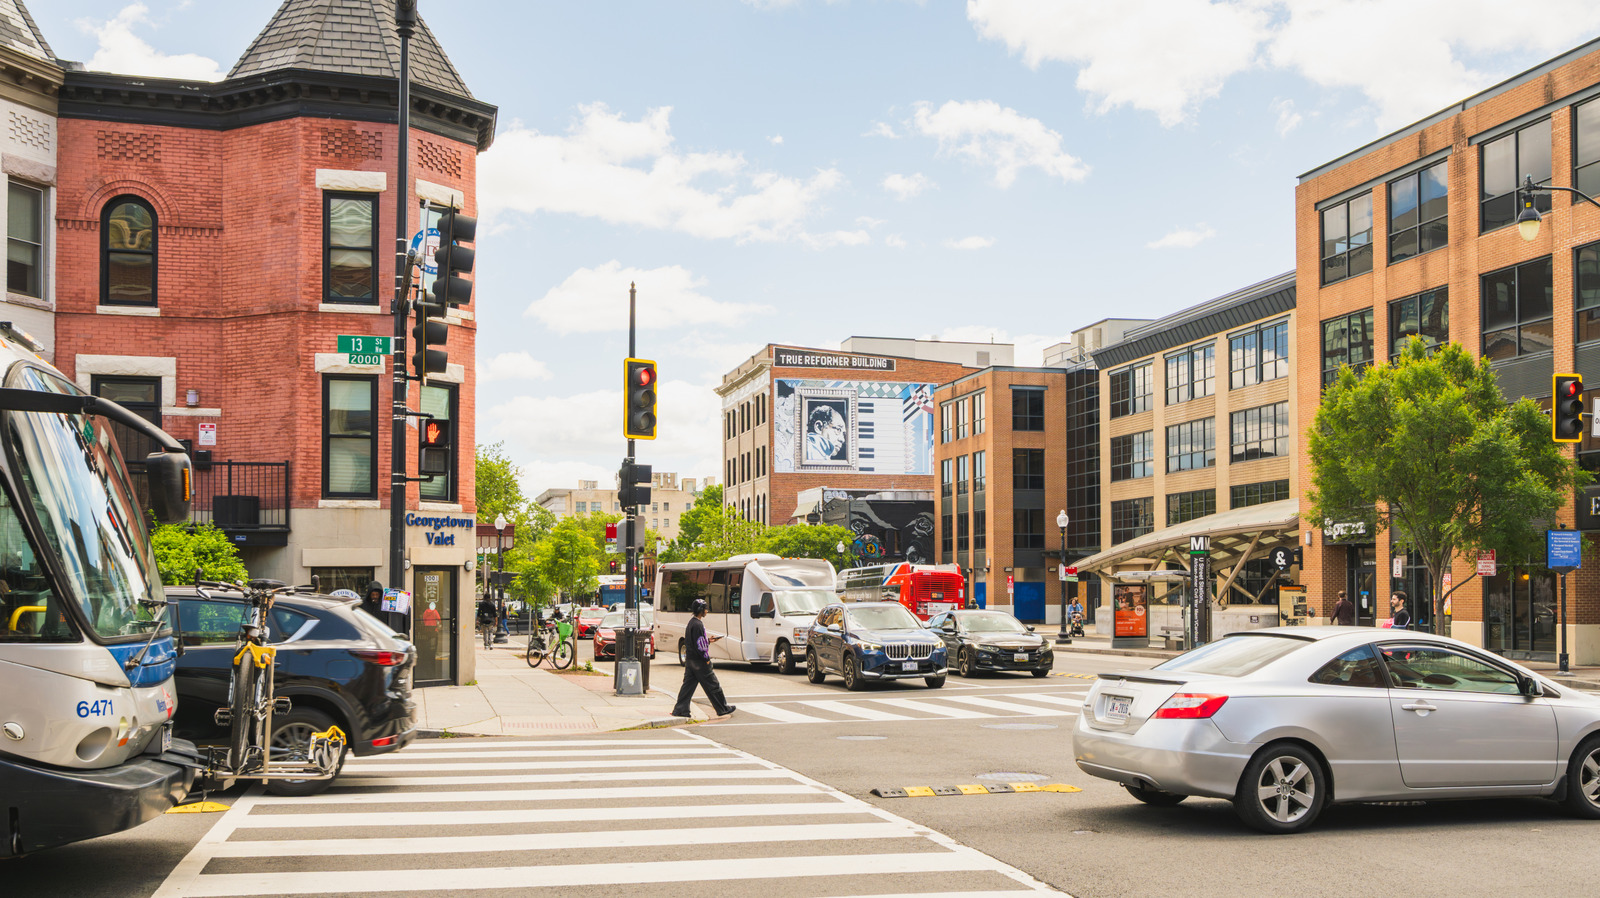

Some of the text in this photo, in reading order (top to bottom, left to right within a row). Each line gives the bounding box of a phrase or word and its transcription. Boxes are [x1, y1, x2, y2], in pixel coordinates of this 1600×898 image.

[351, 337, 363, 351] 13
[350, 354, 379, 364] 2000
[780, 354, 887, 368] TRUE REFORMER BUILDING
[405, 512, 474, 530] Georgetown
[425, 532, 455, 546] Valet
[1190, 536, 1204, 551] M
[1275, 551, 1286, 565] &
[76, 699, 113, 718] 6471
